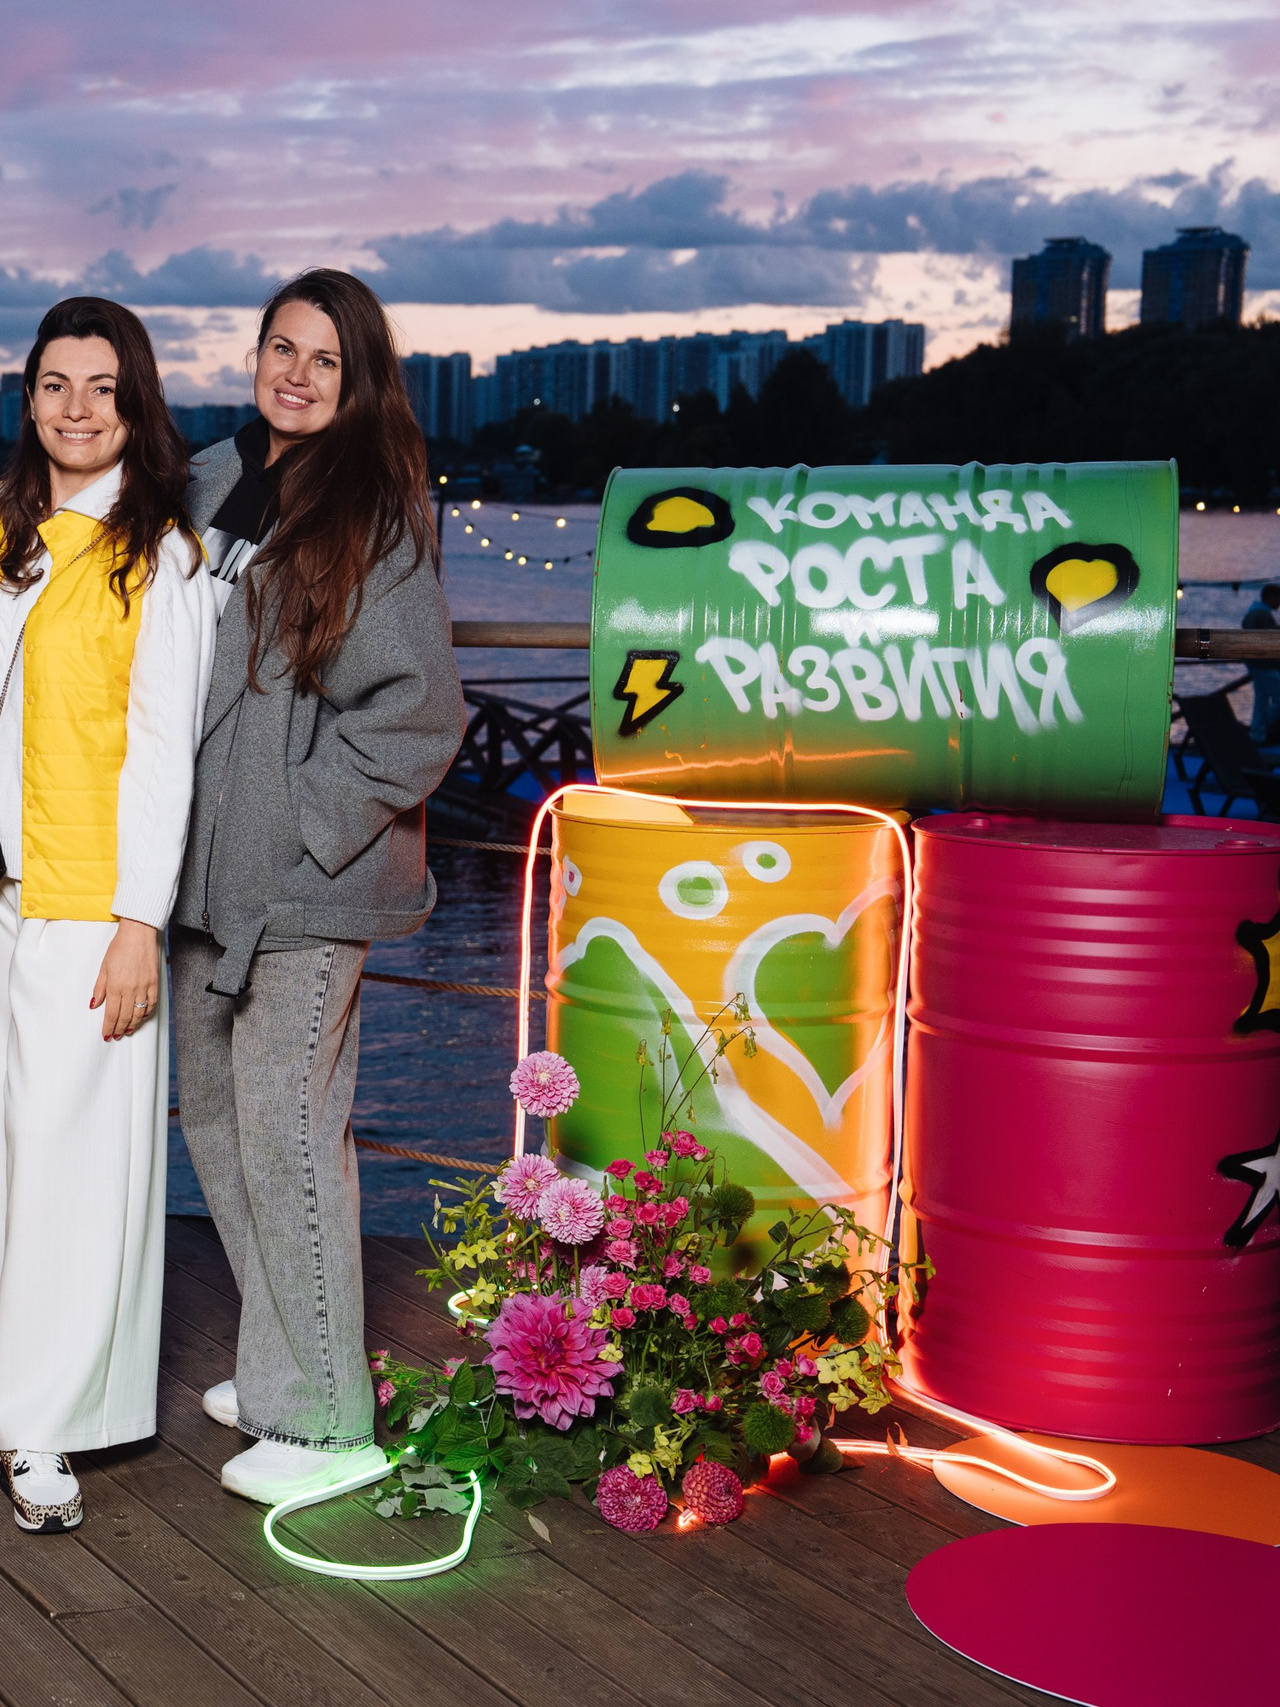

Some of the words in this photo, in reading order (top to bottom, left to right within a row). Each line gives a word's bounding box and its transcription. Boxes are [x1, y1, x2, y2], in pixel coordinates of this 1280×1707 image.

[747, 489, 1073, 533] КОМАНДА
[729, 534, 1005, 609] РОСТА
[695, 636, 1084, 734] РАЗВИТИЯ
